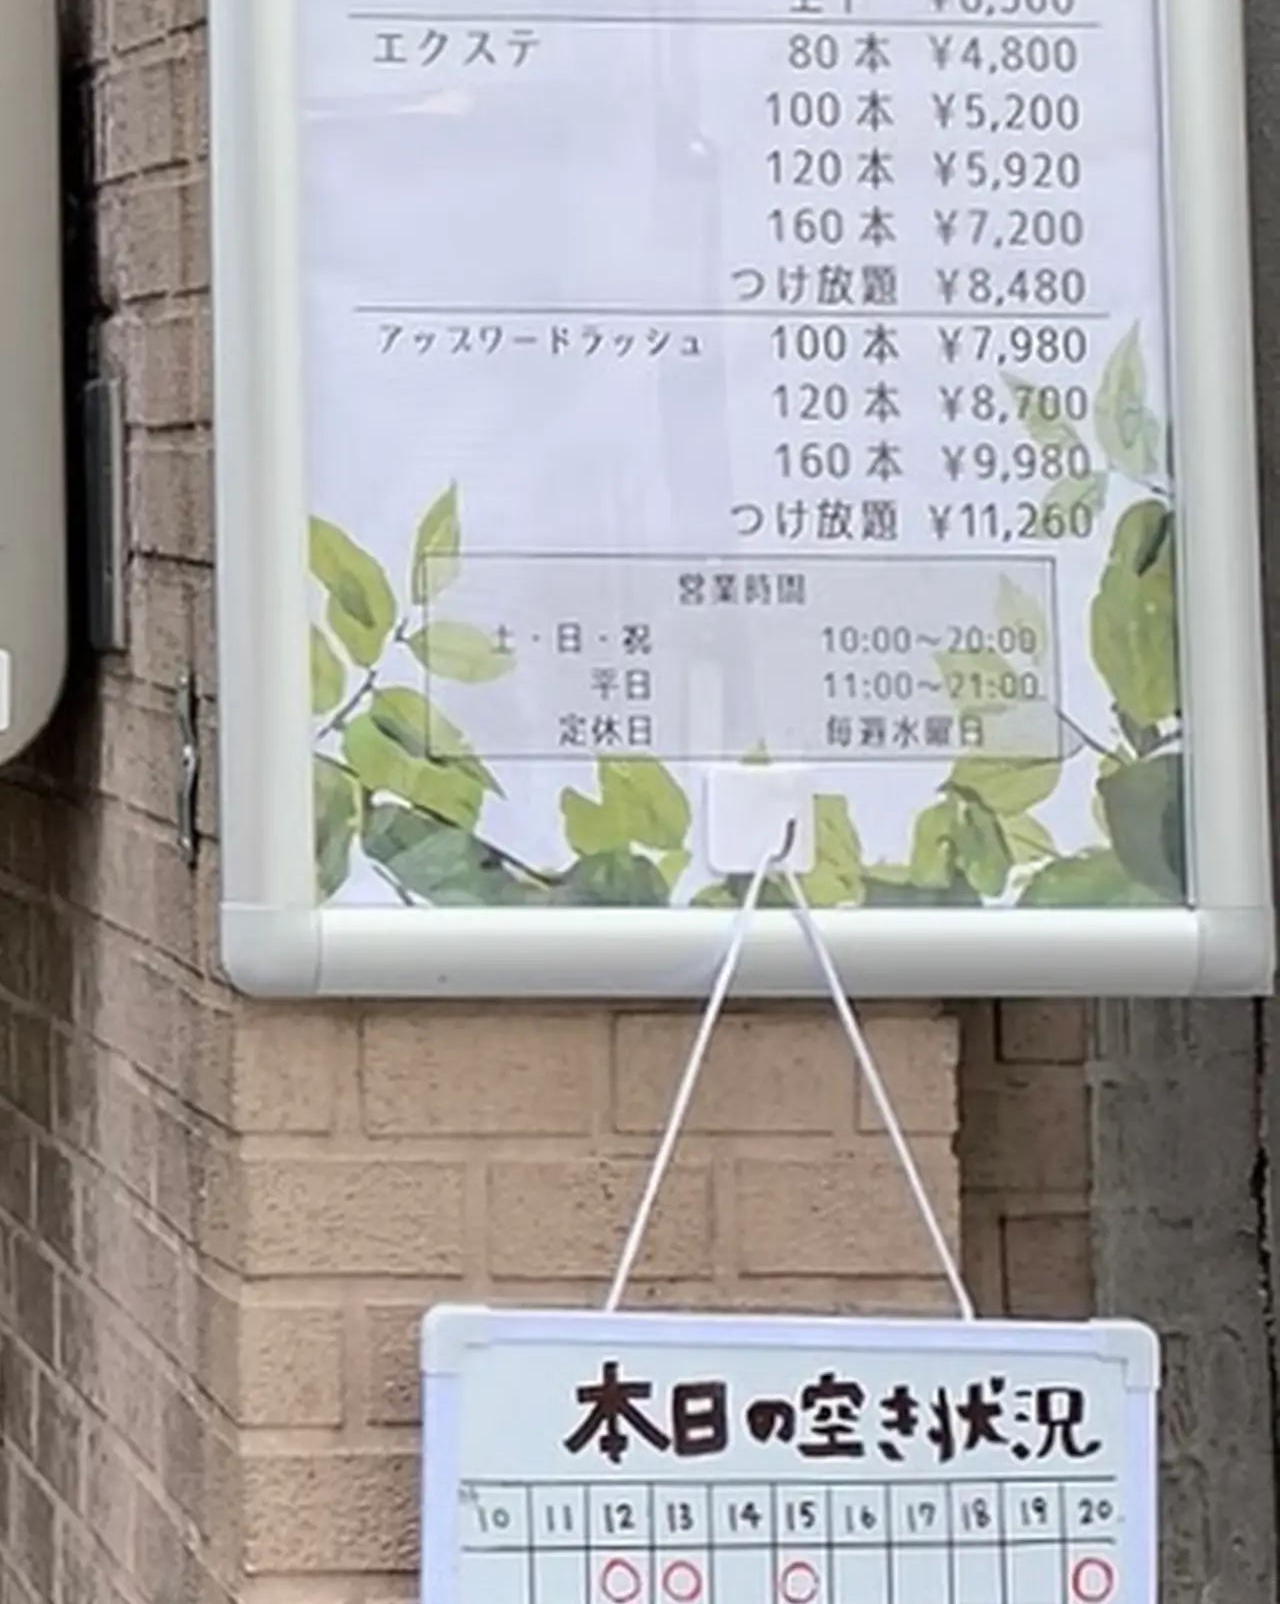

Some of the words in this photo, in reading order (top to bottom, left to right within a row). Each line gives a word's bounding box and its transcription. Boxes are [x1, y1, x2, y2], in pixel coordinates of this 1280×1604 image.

[373, 28, 541, 67] エクステ
[930, 34, 1078, 75] ¥4,800
[932, 92, 1081, 132] ¥5,200
[933, 150, 1082, 191] ¥5,920
[934, 208, 1085, 250] ¥7,200
[730, 264, 899, 306] つけ放題
[936, 267, 1087, 307] ¥8,480
[939, 325, 1088, 366] ¥7,980
[940, 385, 1089, 425] ¥8,700
[942, 443, 1093, 483] ¥9,980
[730, 498, 899, 541] つけ放題
[928, 500, 1094, 543] ¥11,260
[678, 572, 807, 606] 営業時間
[591, 667, 652, 702] 平日
[558, 712, 653, 747] 定休日
[826, 713, 984, 748] 毎週水曜日
[564, 1361, 1102, 1464] 本日の空き状況
[478, 1505, 510, 1533] 10
[545, 1504, 574, 1532] 11
[603, 1502, 636, 1533] 12
[667, 1502, 694, 1533] 13
[728, 1501, 762, 1532] 14
[785, 1500, 816, 1531] 15
[845, 1504, 877, 1533] 16
[907, 1501, 937, 1532] 17
[961, 1497, 991, 1531] 18
[1020, 1496, 1048, 1526] 19
[1078, 1497, 1114, 1524] 20
